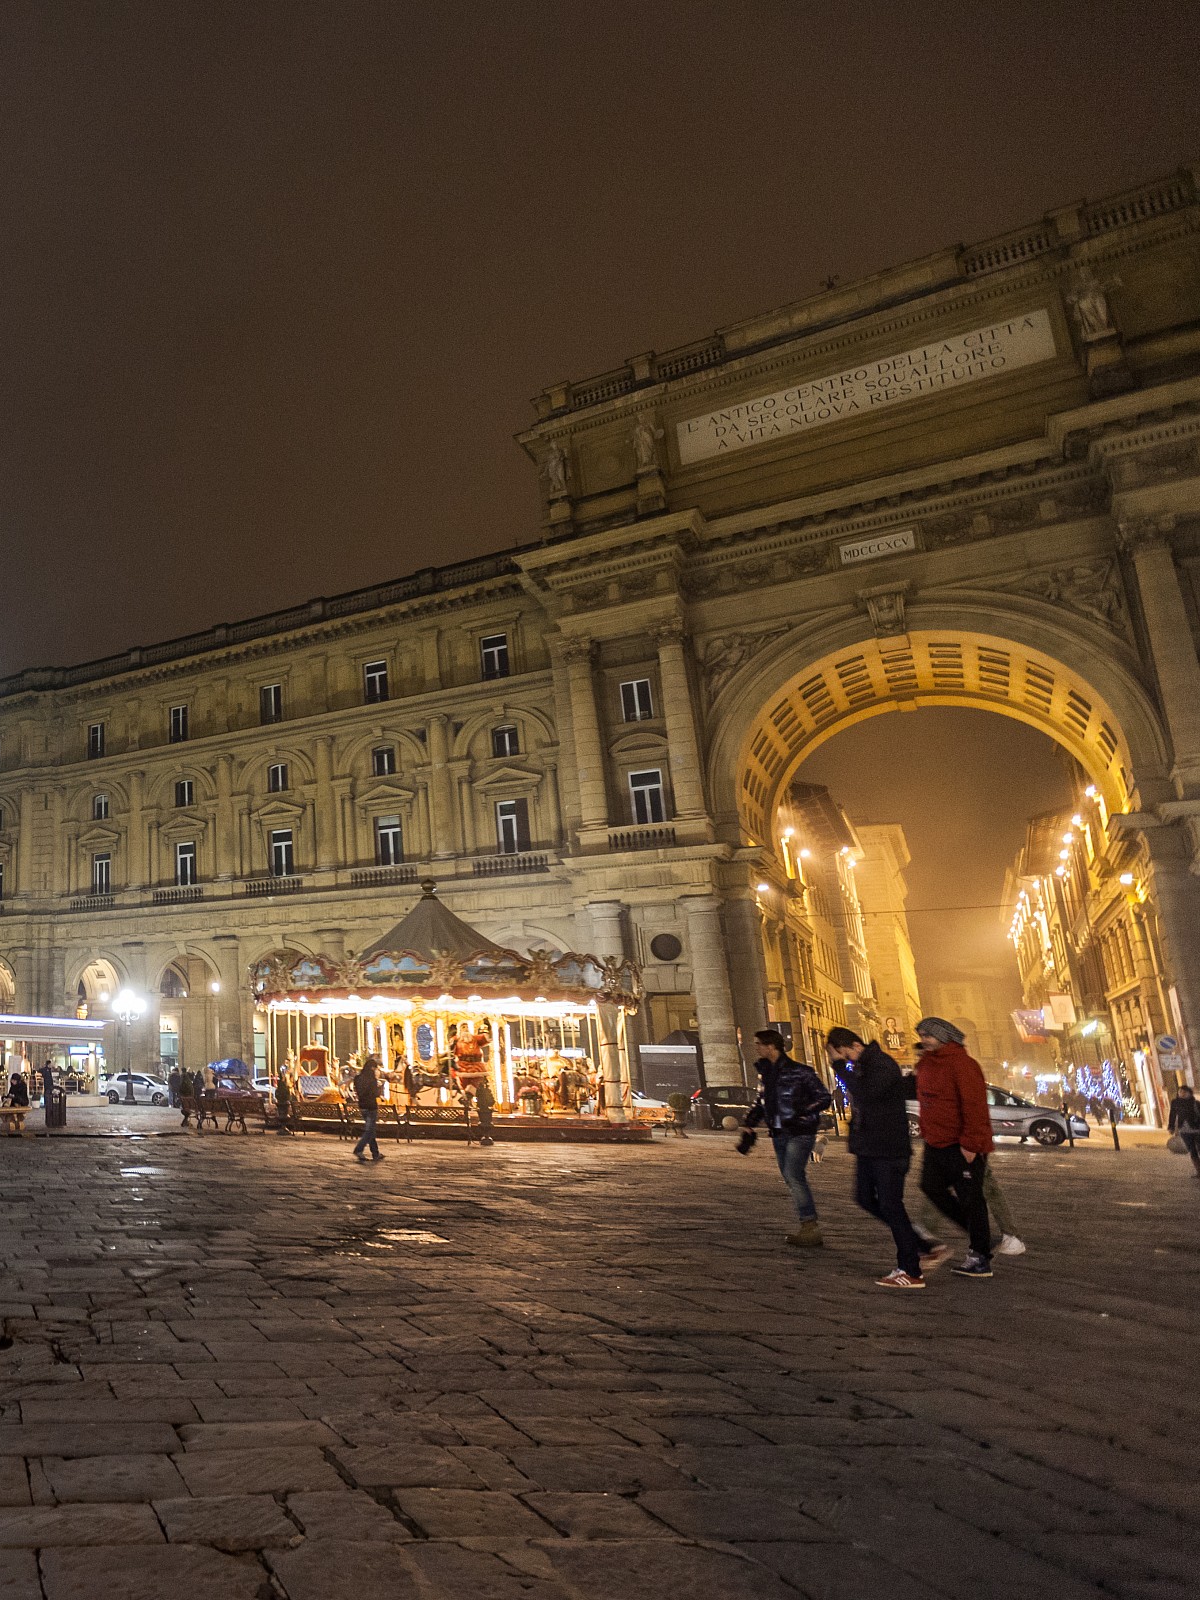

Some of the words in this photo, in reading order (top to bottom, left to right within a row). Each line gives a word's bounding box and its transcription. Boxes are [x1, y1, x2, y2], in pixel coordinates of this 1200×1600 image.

[708, 398, 776, 428] ANTICO
[784, 369, 868, 403] CENTRO
[877, 344, 953, 376] DELLA
[715, 423, 739, 438] DA
[747, 386, 856, 427] SECOLARE
[864, 342, 1003, 392] SQUALLORE
[718, 439, 728, 450] A
[736, 423, 781, 443] VITA
[790, 400, 860, 428] NUOVA
[870, 356, 1007, 405] RESTITUITO
[843, 536, 910, 560] MDCCCXCV
